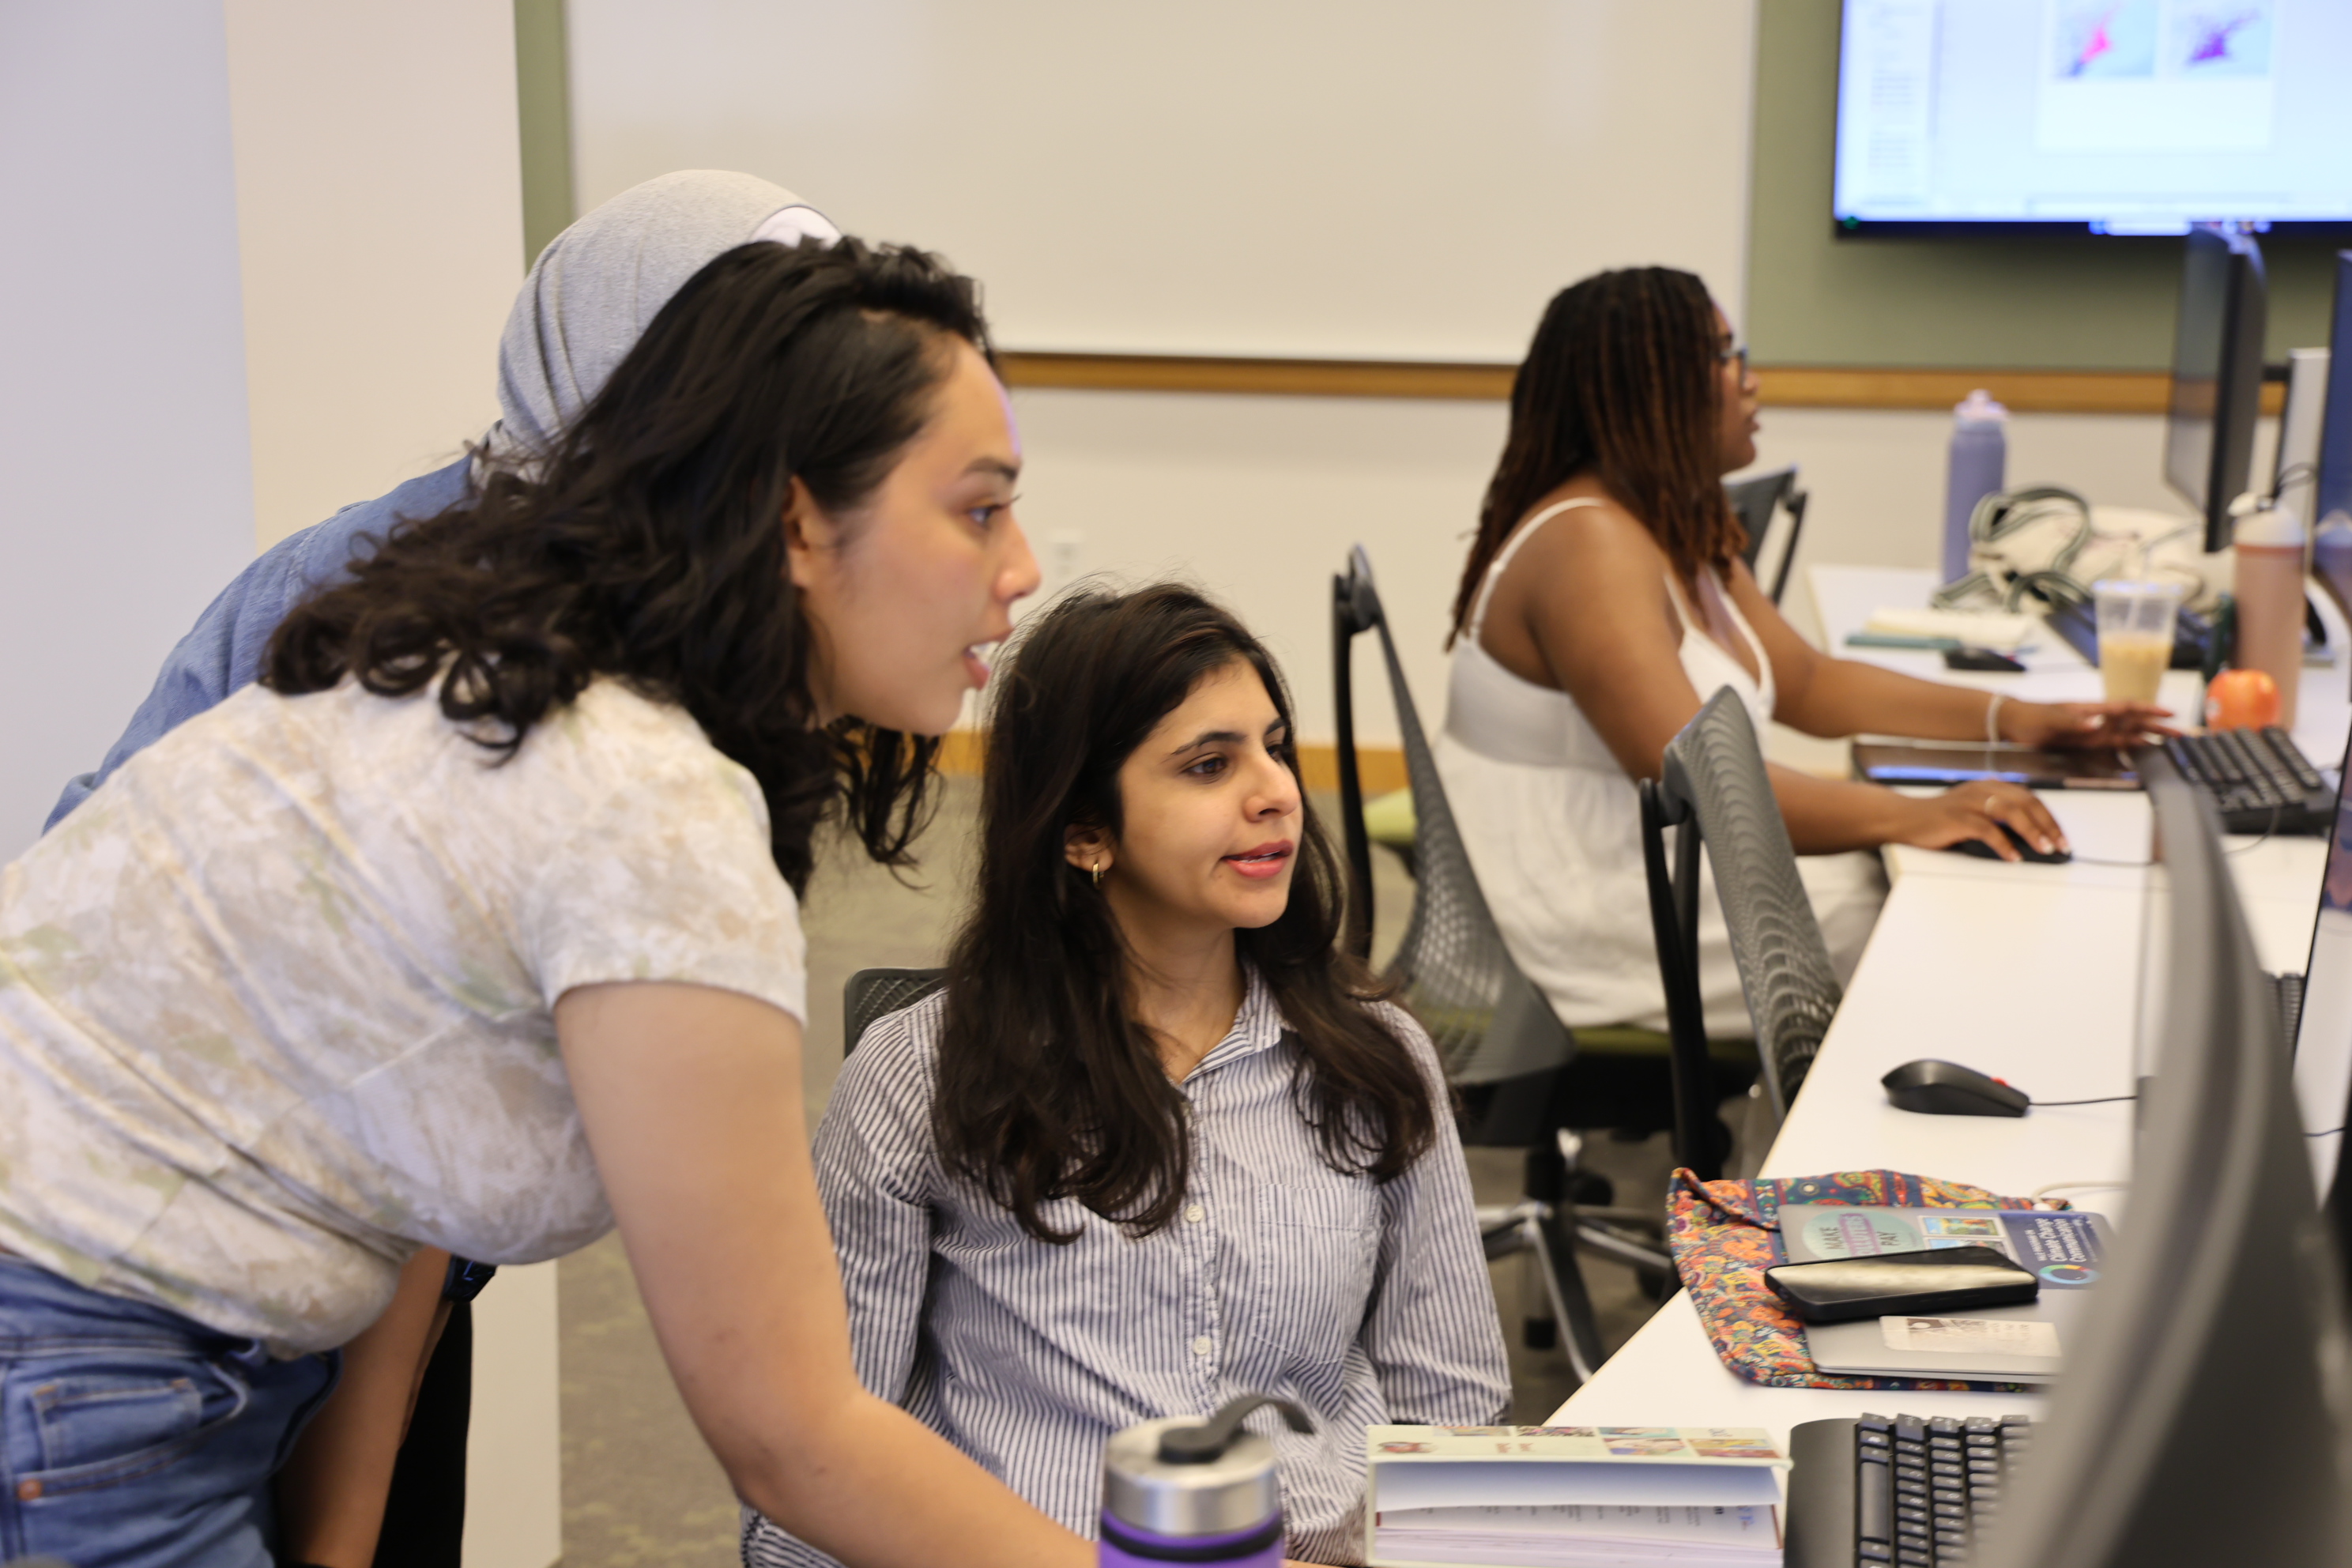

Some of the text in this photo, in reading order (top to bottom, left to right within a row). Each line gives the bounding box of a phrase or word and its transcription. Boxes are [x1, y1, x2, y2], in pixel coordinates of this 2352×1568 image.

[1819, 1227, 1845, 1249] MAKE
[1846, 1216, 1875, 1256] OLLUTERS
[1878, 1231, 1901, 1246] PAY
[2035, 1218, 2067, 1261] Climate Change
[2053, 1218, 2087, 1262] Communication
